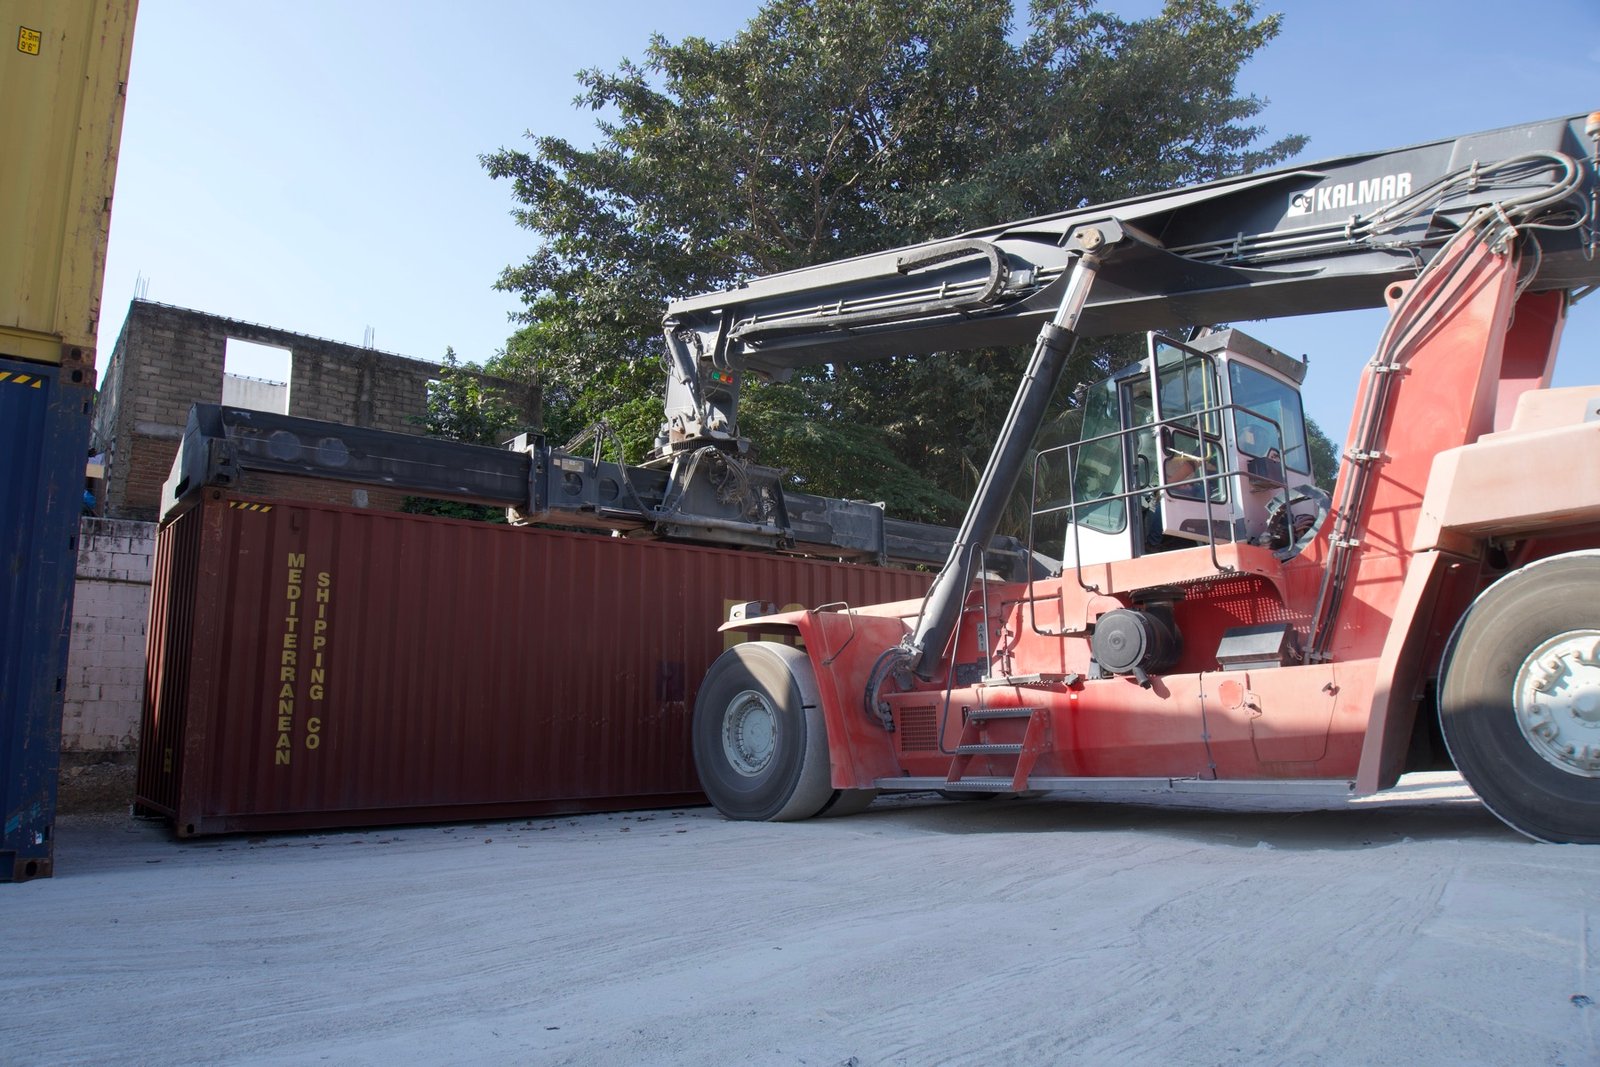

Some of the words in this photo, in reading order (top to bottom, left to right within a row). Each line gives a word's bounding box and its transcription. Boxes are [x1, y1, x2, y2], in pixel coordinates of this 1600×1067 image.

[1317, 172, 1412, 212] KALMAR
[275, 552, 305, 765] MEDITERRANEAN
[309, 572, 330, 700] SHIPPING
[305, 717, 321, 750] CO
